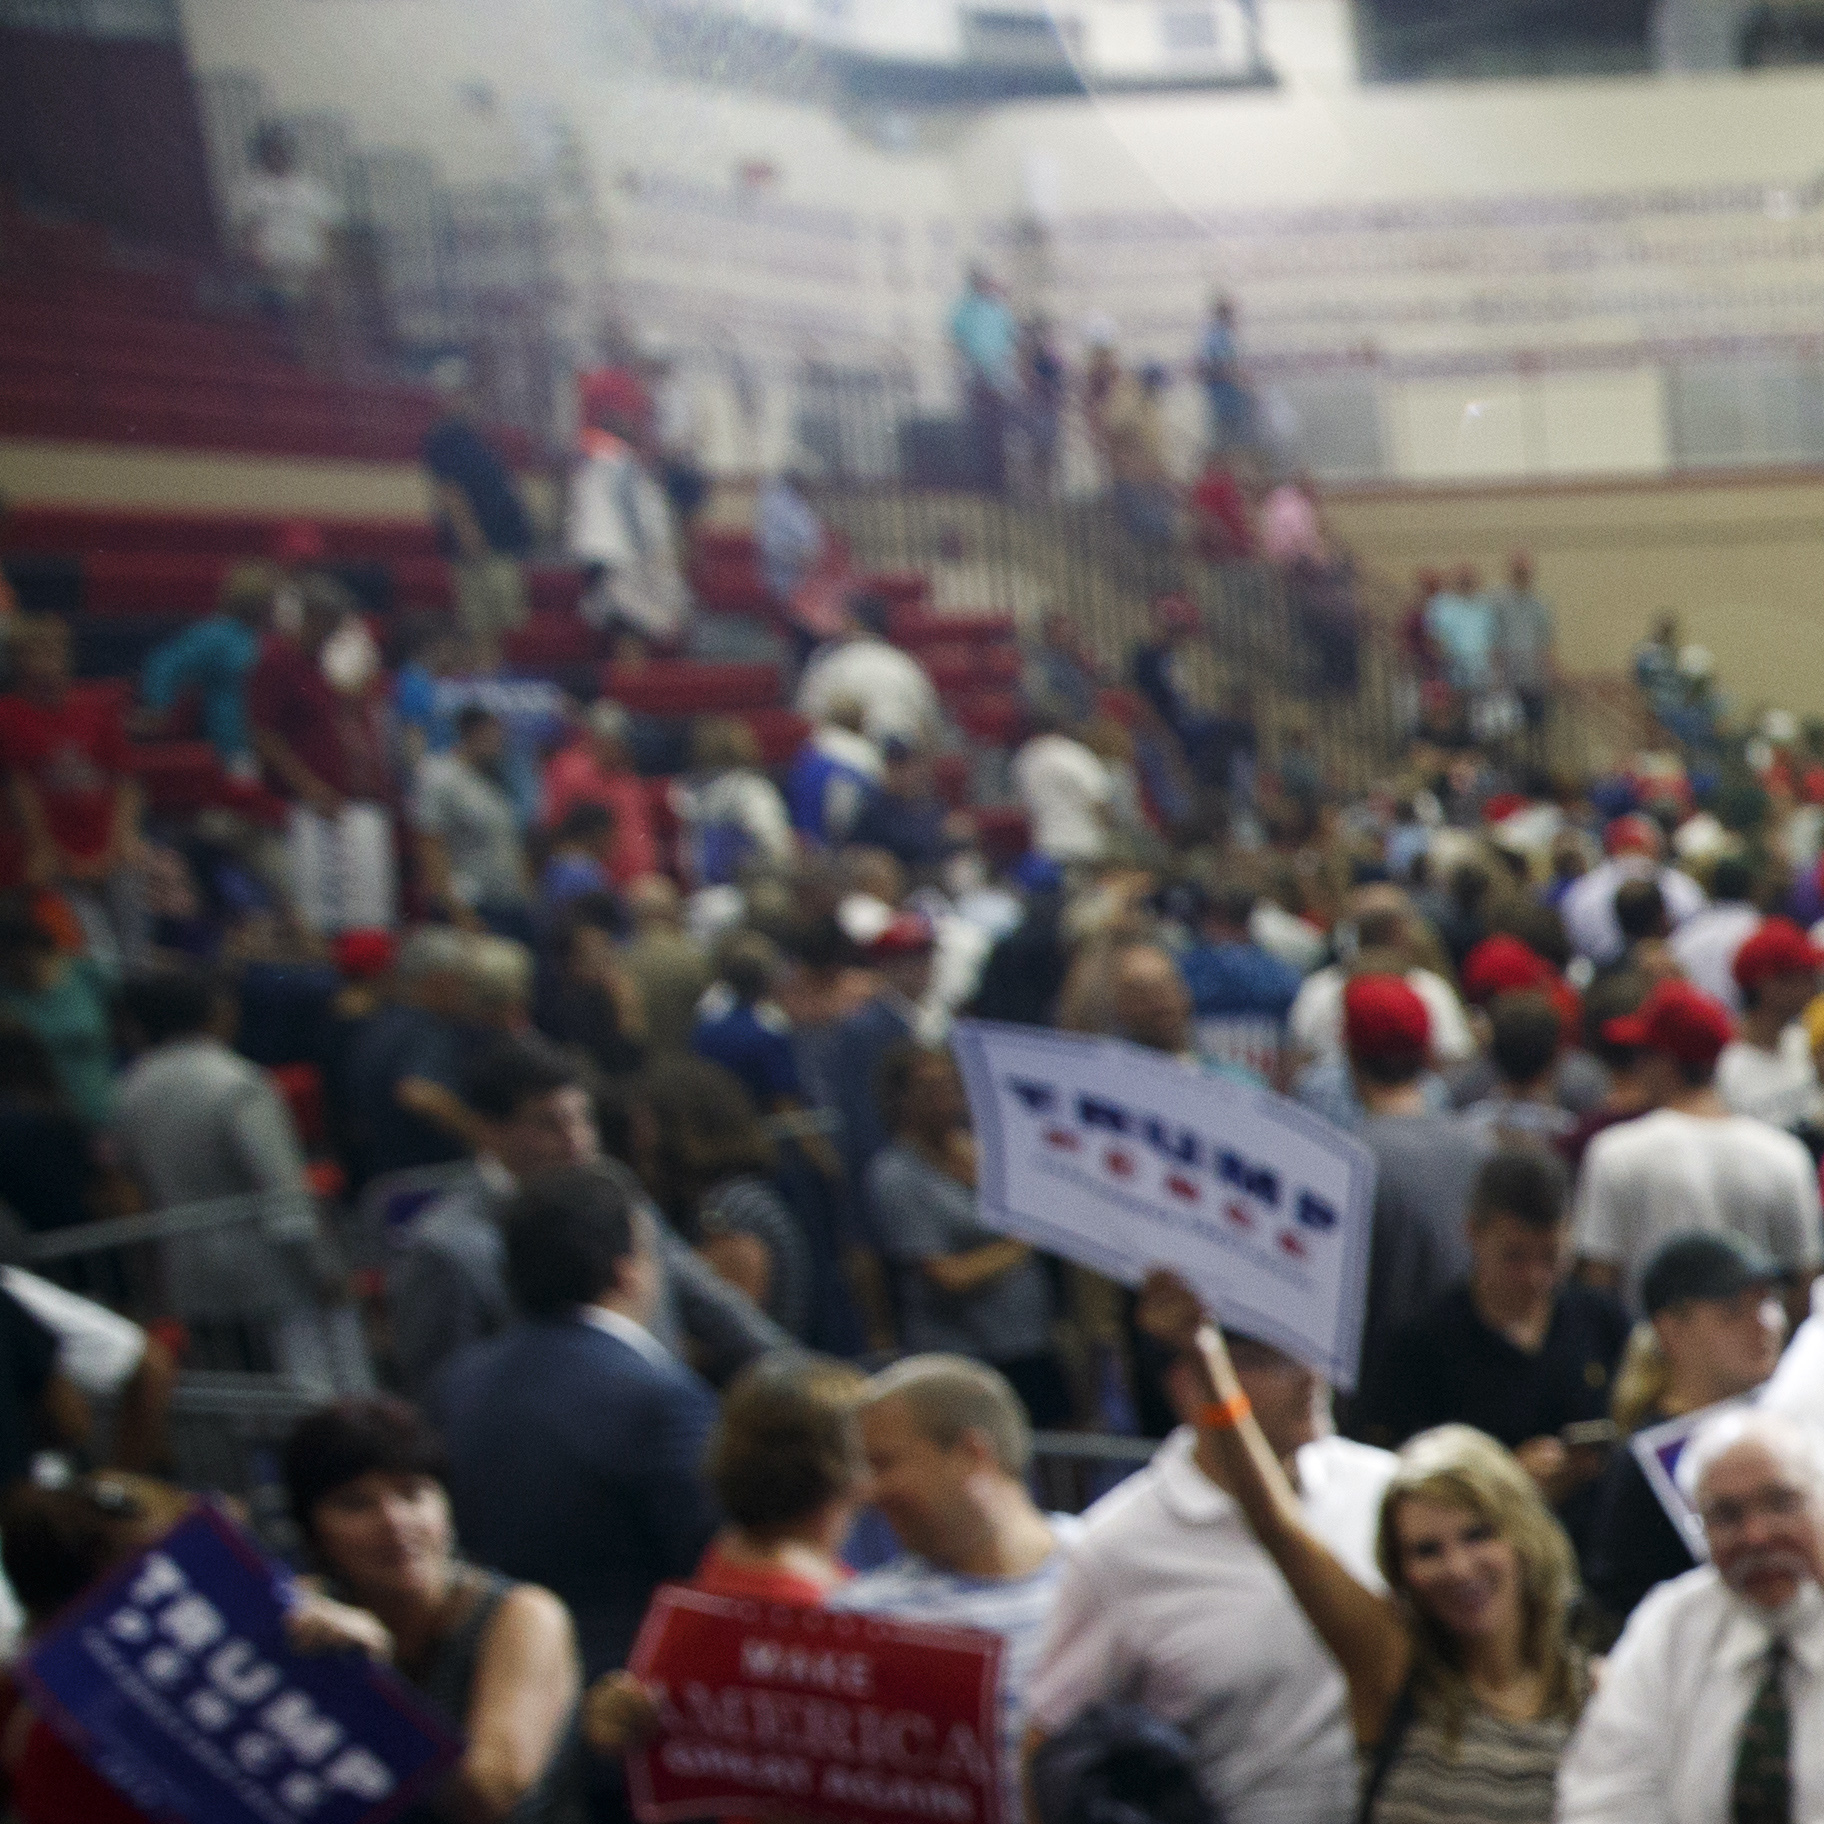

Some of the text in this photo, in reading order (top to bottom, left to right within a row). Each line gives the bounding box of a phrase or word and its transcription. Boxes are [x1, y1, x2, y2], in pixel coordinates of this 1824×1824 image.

[1005, 1074, 1340, 1237] TRUMP
[130, 1552, 394, 1798] TRUMP
[642, 1678, 994, 1786] AMERICA
[741, 1638, 876, 1698] MAKE
